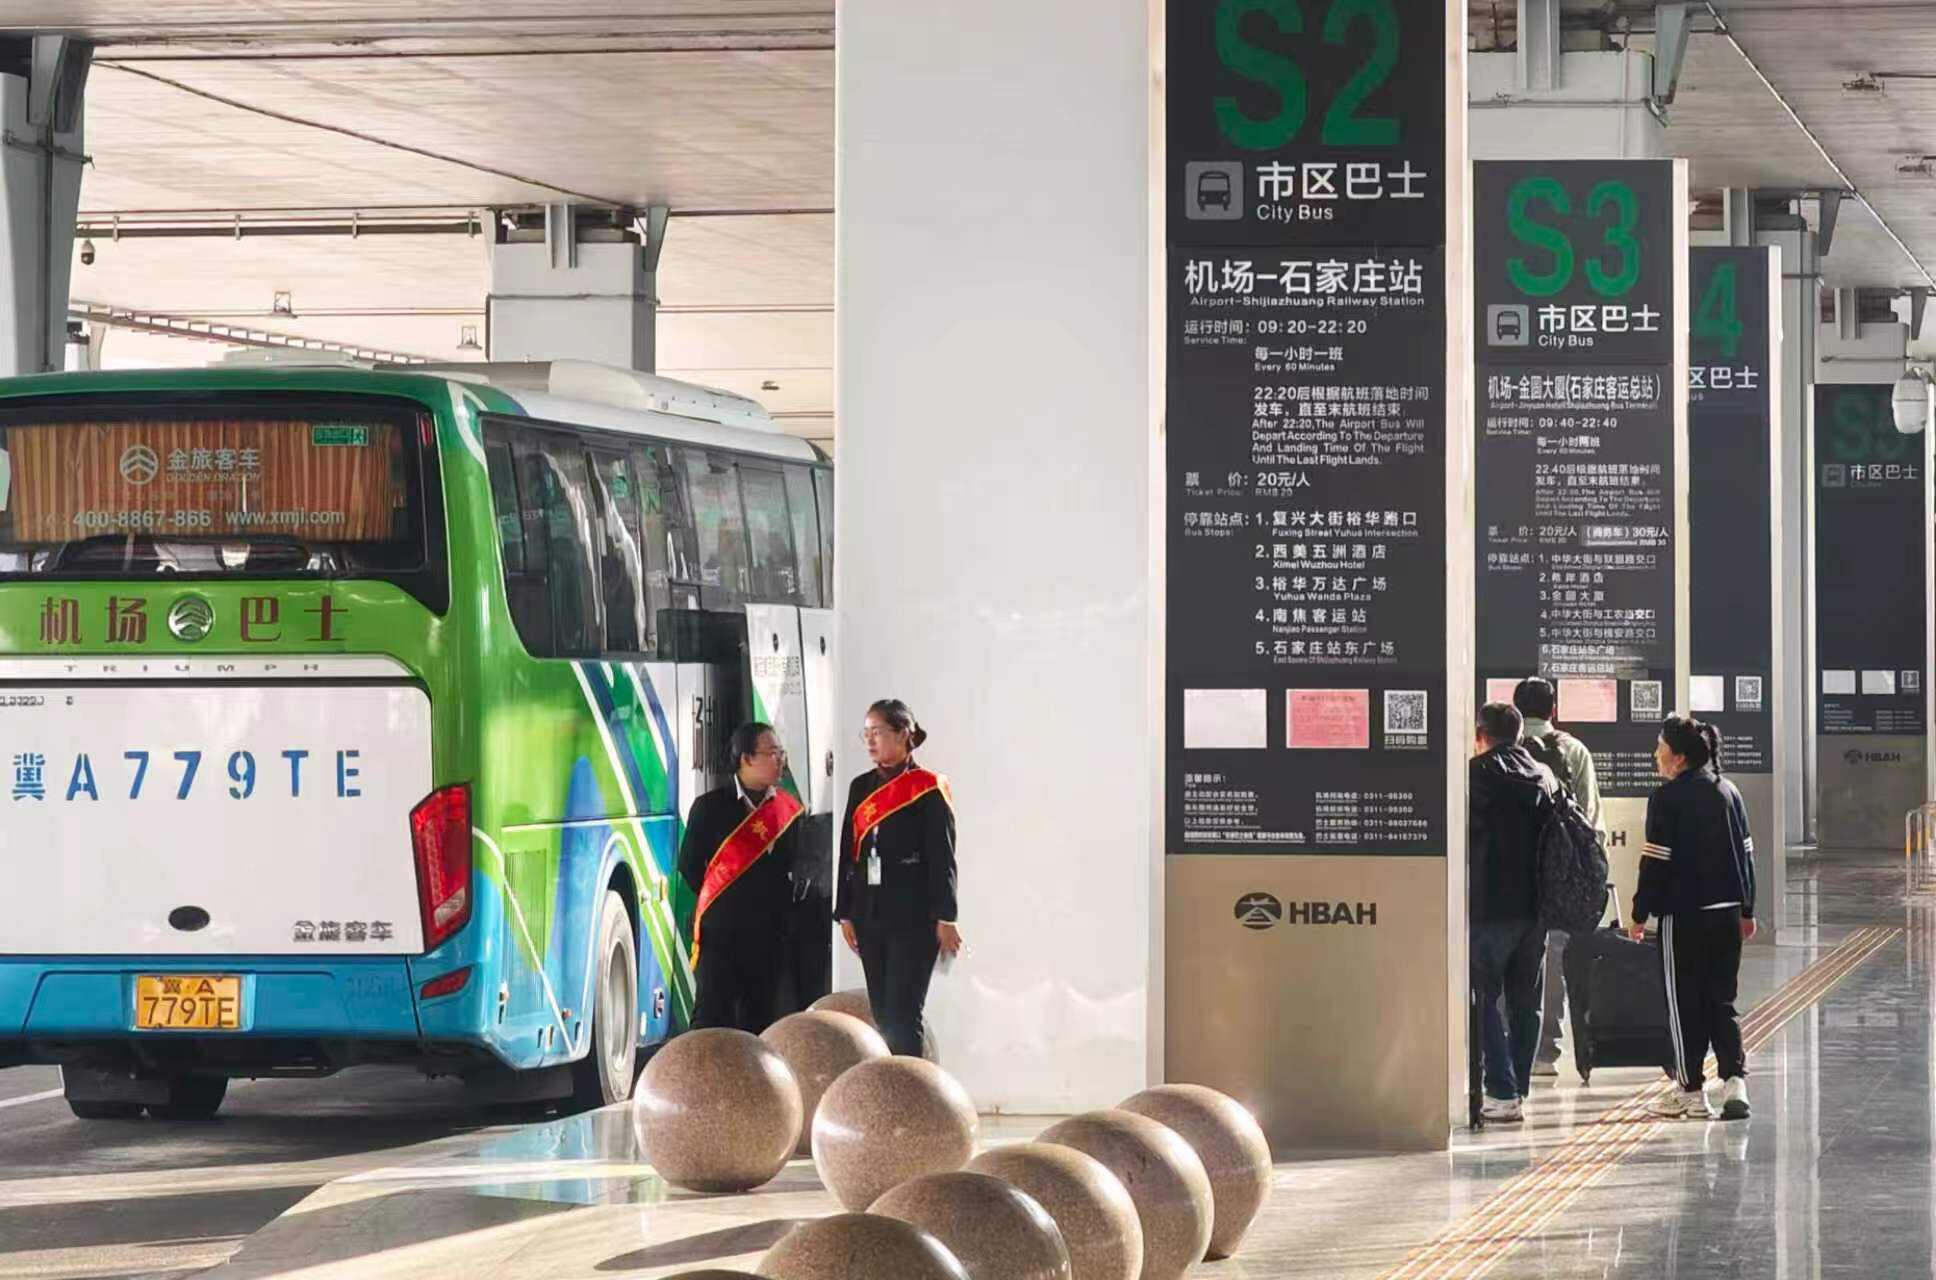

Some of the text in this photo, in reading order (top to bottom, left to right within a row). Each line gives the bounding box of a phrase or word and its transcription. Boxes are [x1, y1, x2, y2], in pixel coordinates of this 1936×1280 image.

[1213, 0, 1402, 150] S2
[1256, 161, 1427, 201] 市区巴士
[1256, 205, 1333, 223] City Bus
[1507, 176, 1640, 296] S3
[1191, 297, 1424, 307] Airport-Shijiazhuang Railway Station
[1538, 304, 1660, 333] 市区巴士
[1184, 336, 1219, 344] Service
[1538, 335, 1594, 348] City Bus
[1254, 347, 1343, 361] 每一小时一班
[1254, 363, 1281, 373] Every
[1299, 363, 1335, 371] Minutes
[1252, 419, 1277, 429] After
[1340, 419, 1375, 430] Airport
[1406, 419, 1424, 429] Will
[1252, 431, 1424, 441] Depart According To The Departure
[1252, 443, 1424, 454] And Landing Time Of The Flight
[167, 448, 260, 470] 金旅客车
[1252, 454, 1275, 464] Until
[1277, 454, 1295, 464] The
[1297, 454, 1318, 464] Last
[1320, 454, 1347, 466] Flight
[1850, 464, 1918, 480] 市区巴士
[1257, 472, 1310, 487] 20元/人
[73, 510, 211, 528] 400-8867-866
[1272, 528, 1303, 538] Fuxing
[1335, 528, 1363, 538] Yuhua
[1300, 560, 1340, 569] Wuzhou
[1340, 560, 1365, 569] Hotel
[1274, 592, 1371, 600] Yuhua Wanda Plaza
[40, 595, 348, 645] 机场 巴士
[64, 665, 320, 673] TRIUMPH
[13, 751, 361, 801] 冀A779TE
[1289, 902, 1377, 925] HBAH
[143, 997, 235, 1025] 779TE
